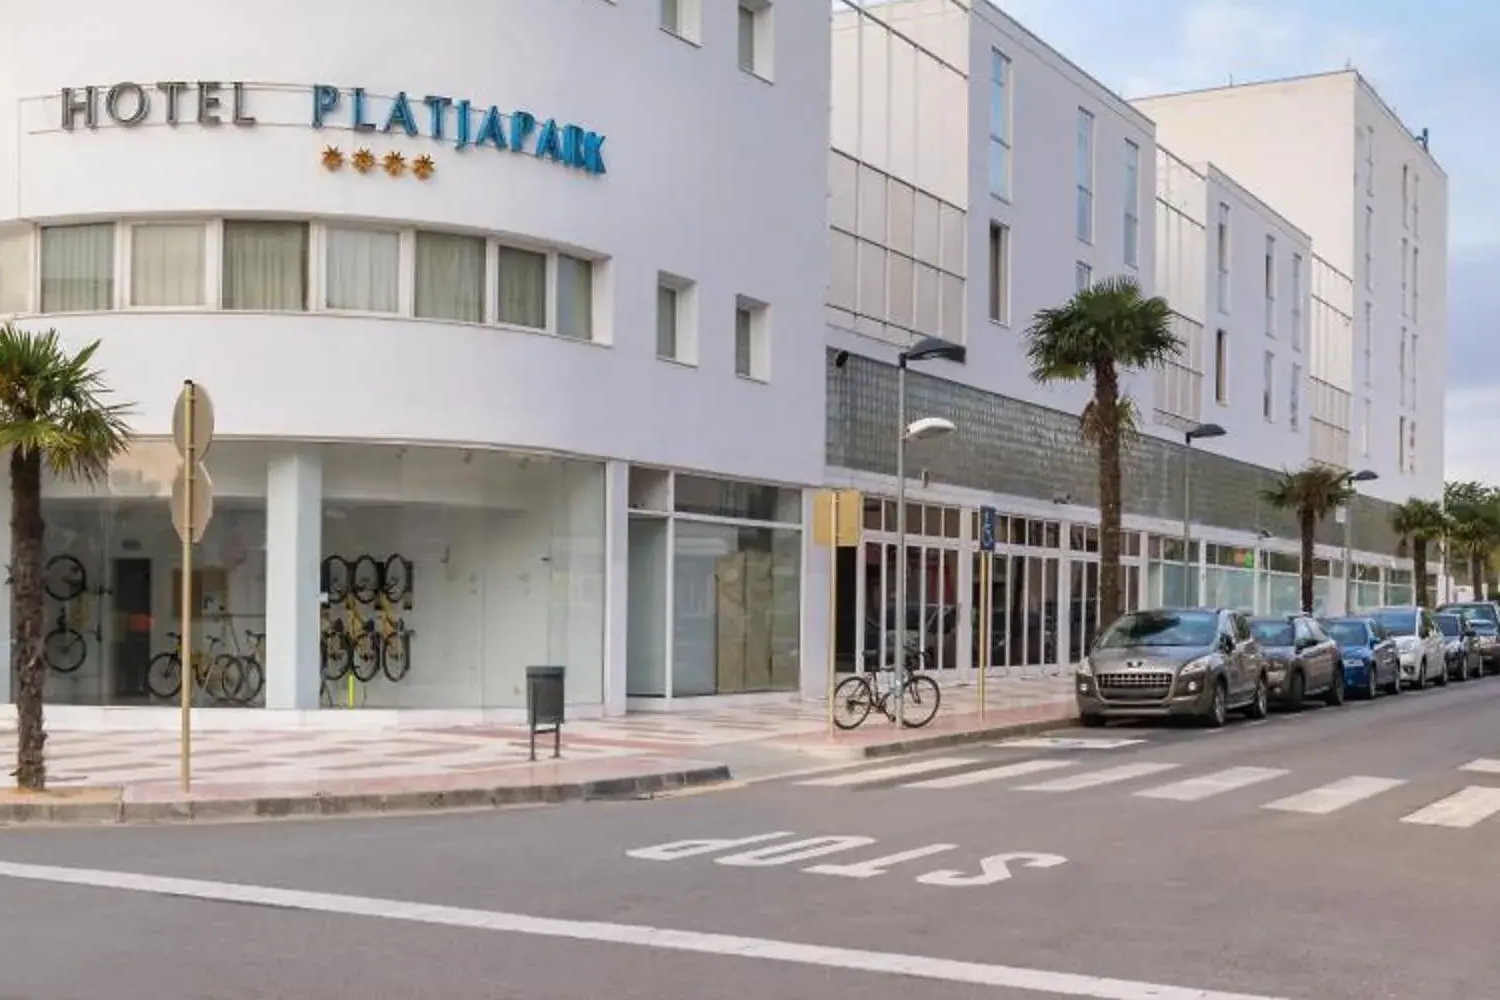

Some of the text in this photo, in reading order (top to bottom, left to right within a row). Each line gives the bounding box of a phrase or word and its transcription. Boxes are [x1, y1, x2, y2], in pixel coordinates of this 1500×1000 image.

[61, 81, 606, 174] HOTEL PLATJAPARK
[625, 831, 1069, 886] STOP
